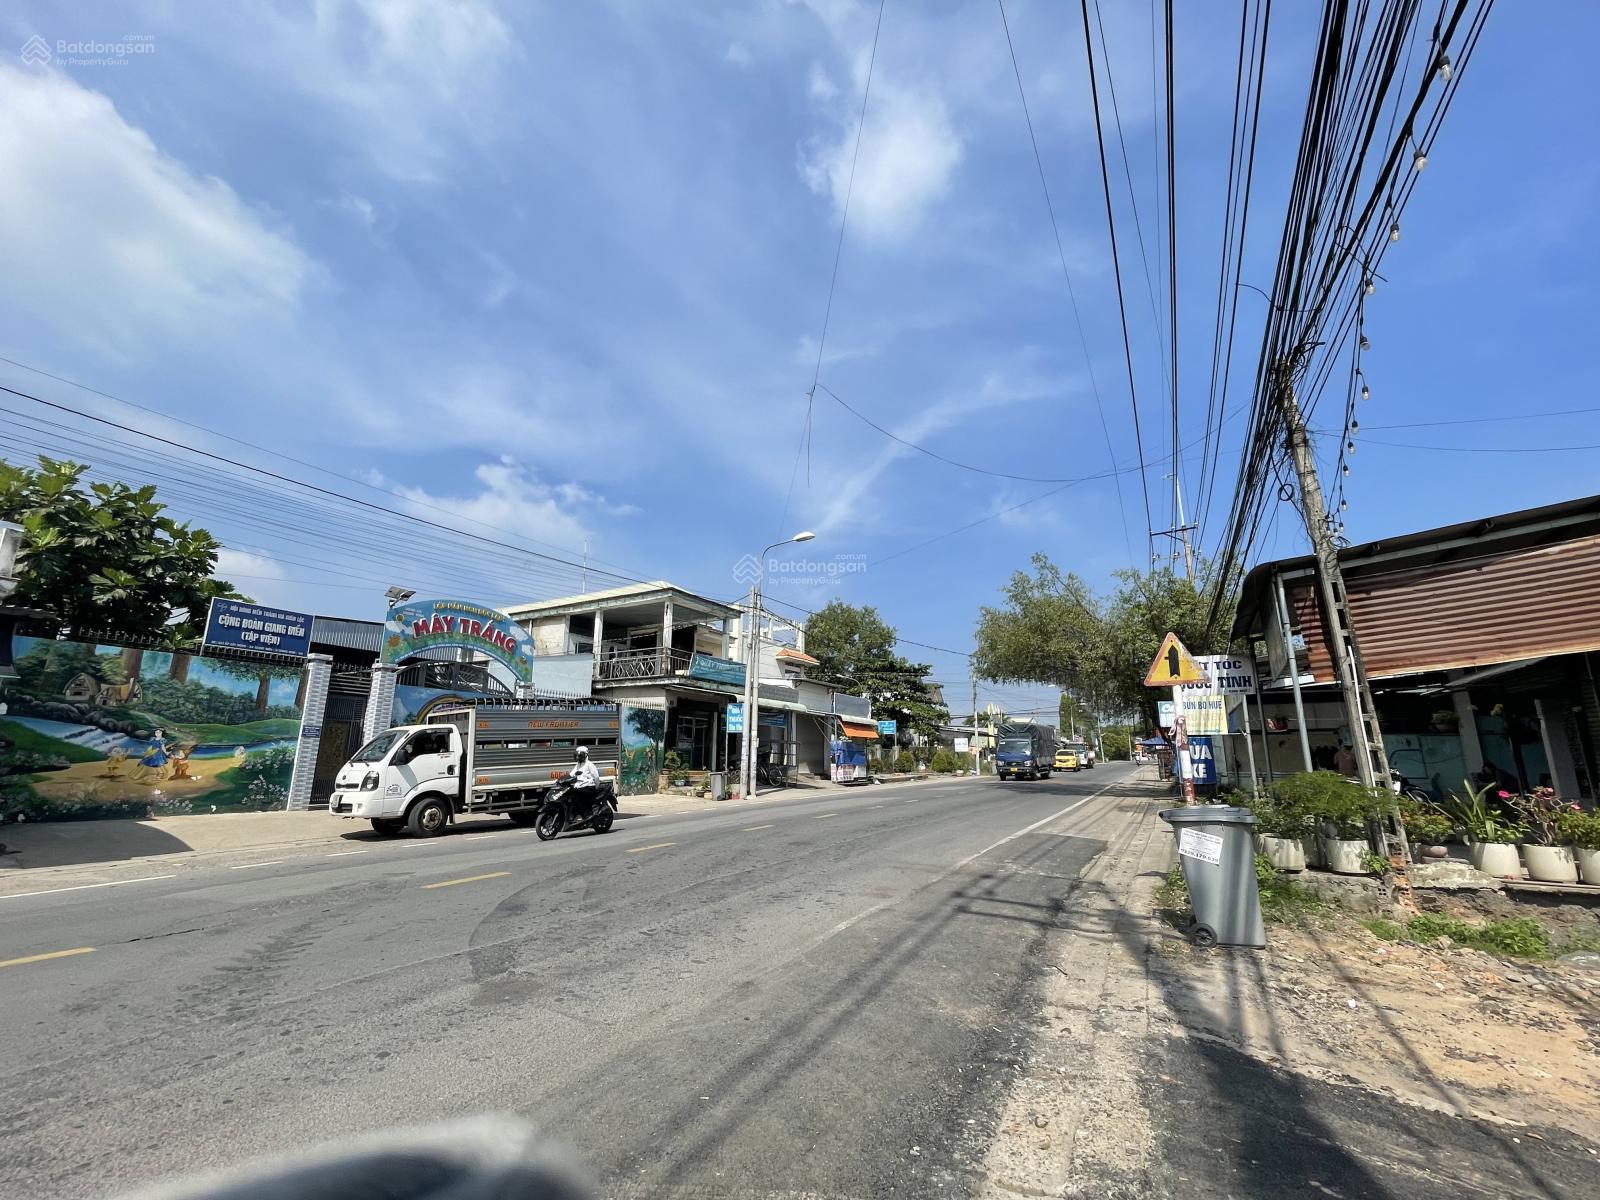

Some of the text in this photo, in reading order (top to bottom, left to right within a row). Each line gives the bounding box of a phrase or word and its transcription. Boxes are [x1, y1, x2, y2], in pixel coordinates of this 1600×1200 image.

[218, 613, 241, 628] CỘNG
[264, 621, 287, 635] GIANG
[412, 613, 456, 639] MÂY
